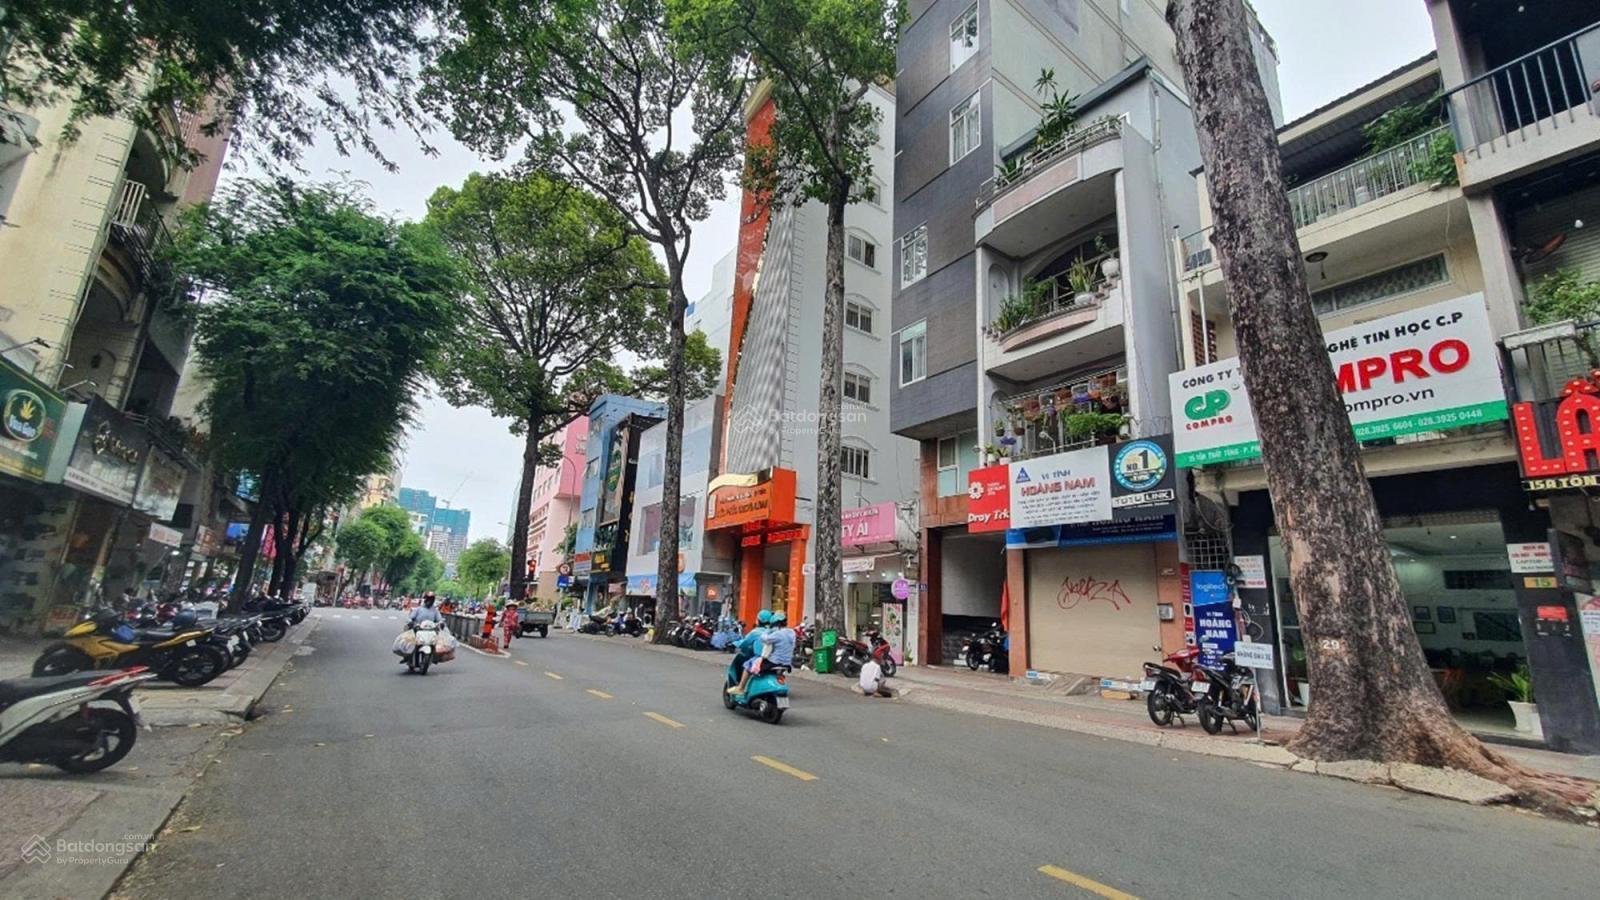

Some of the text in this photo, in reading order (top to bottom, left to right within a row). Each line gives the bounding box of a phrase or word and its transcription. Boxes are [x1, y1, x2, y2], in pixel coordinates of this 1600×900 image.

[1327, 311, 1463, 354] GHỆ TIN HỌC C.P
[1217, 369, 1233, 380] TY
[1336, 338, 1471, 395] MPRO
[1344, 388, 1435, 415] ompro.vn
[1185, 415, 1233, 431] COMPRO
[1021, 481, 1063, 497] HOÀNG
[1064, 476, 1096, 490] NAM
[1199, 617, 1233, 629] HOÀNG
[1204, 629, 1229, 639] NAM
[1322, 639, 1340, 650] 29
